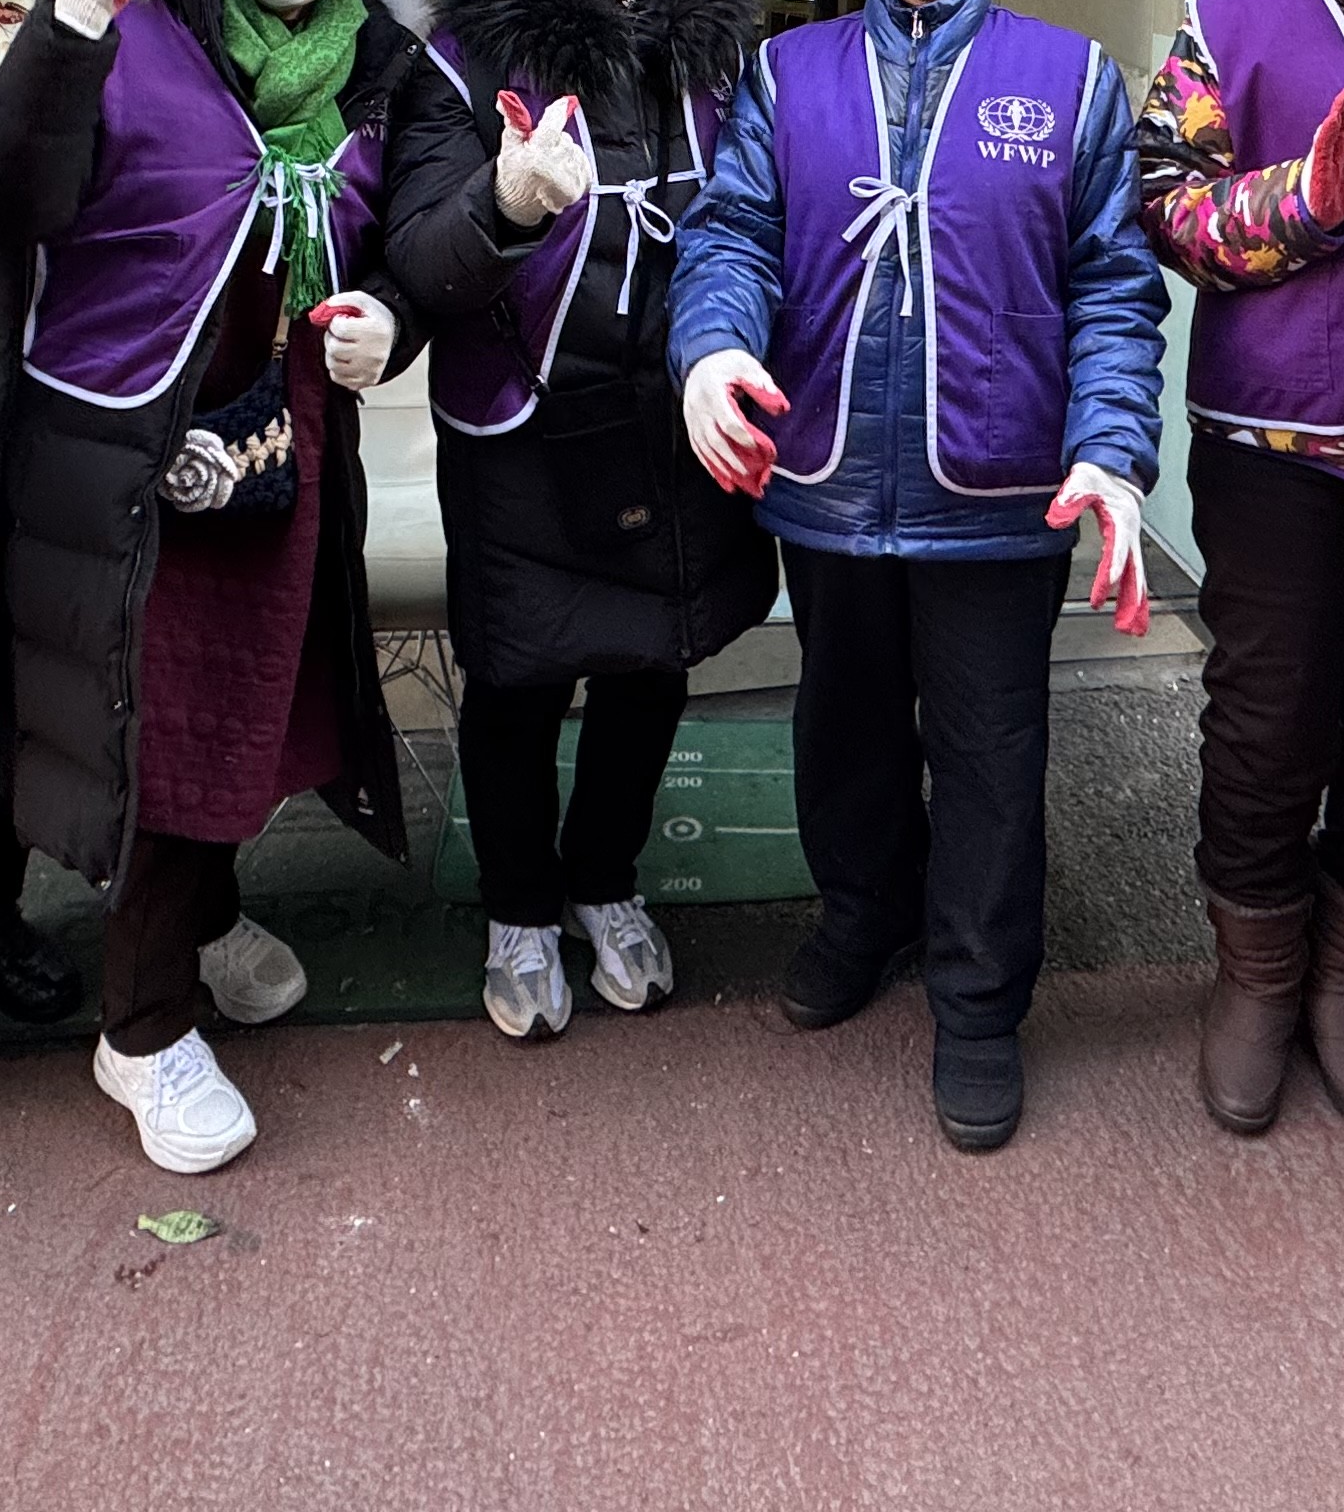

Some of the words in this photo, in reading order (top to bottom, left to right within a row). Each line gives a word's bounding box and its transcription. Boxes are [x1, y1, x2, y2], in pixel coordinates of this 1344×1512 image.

[977, 141, 1056, 168] WFWP
[664, 776, 703, 788] 200
[660, 877, 702, 891] 200
